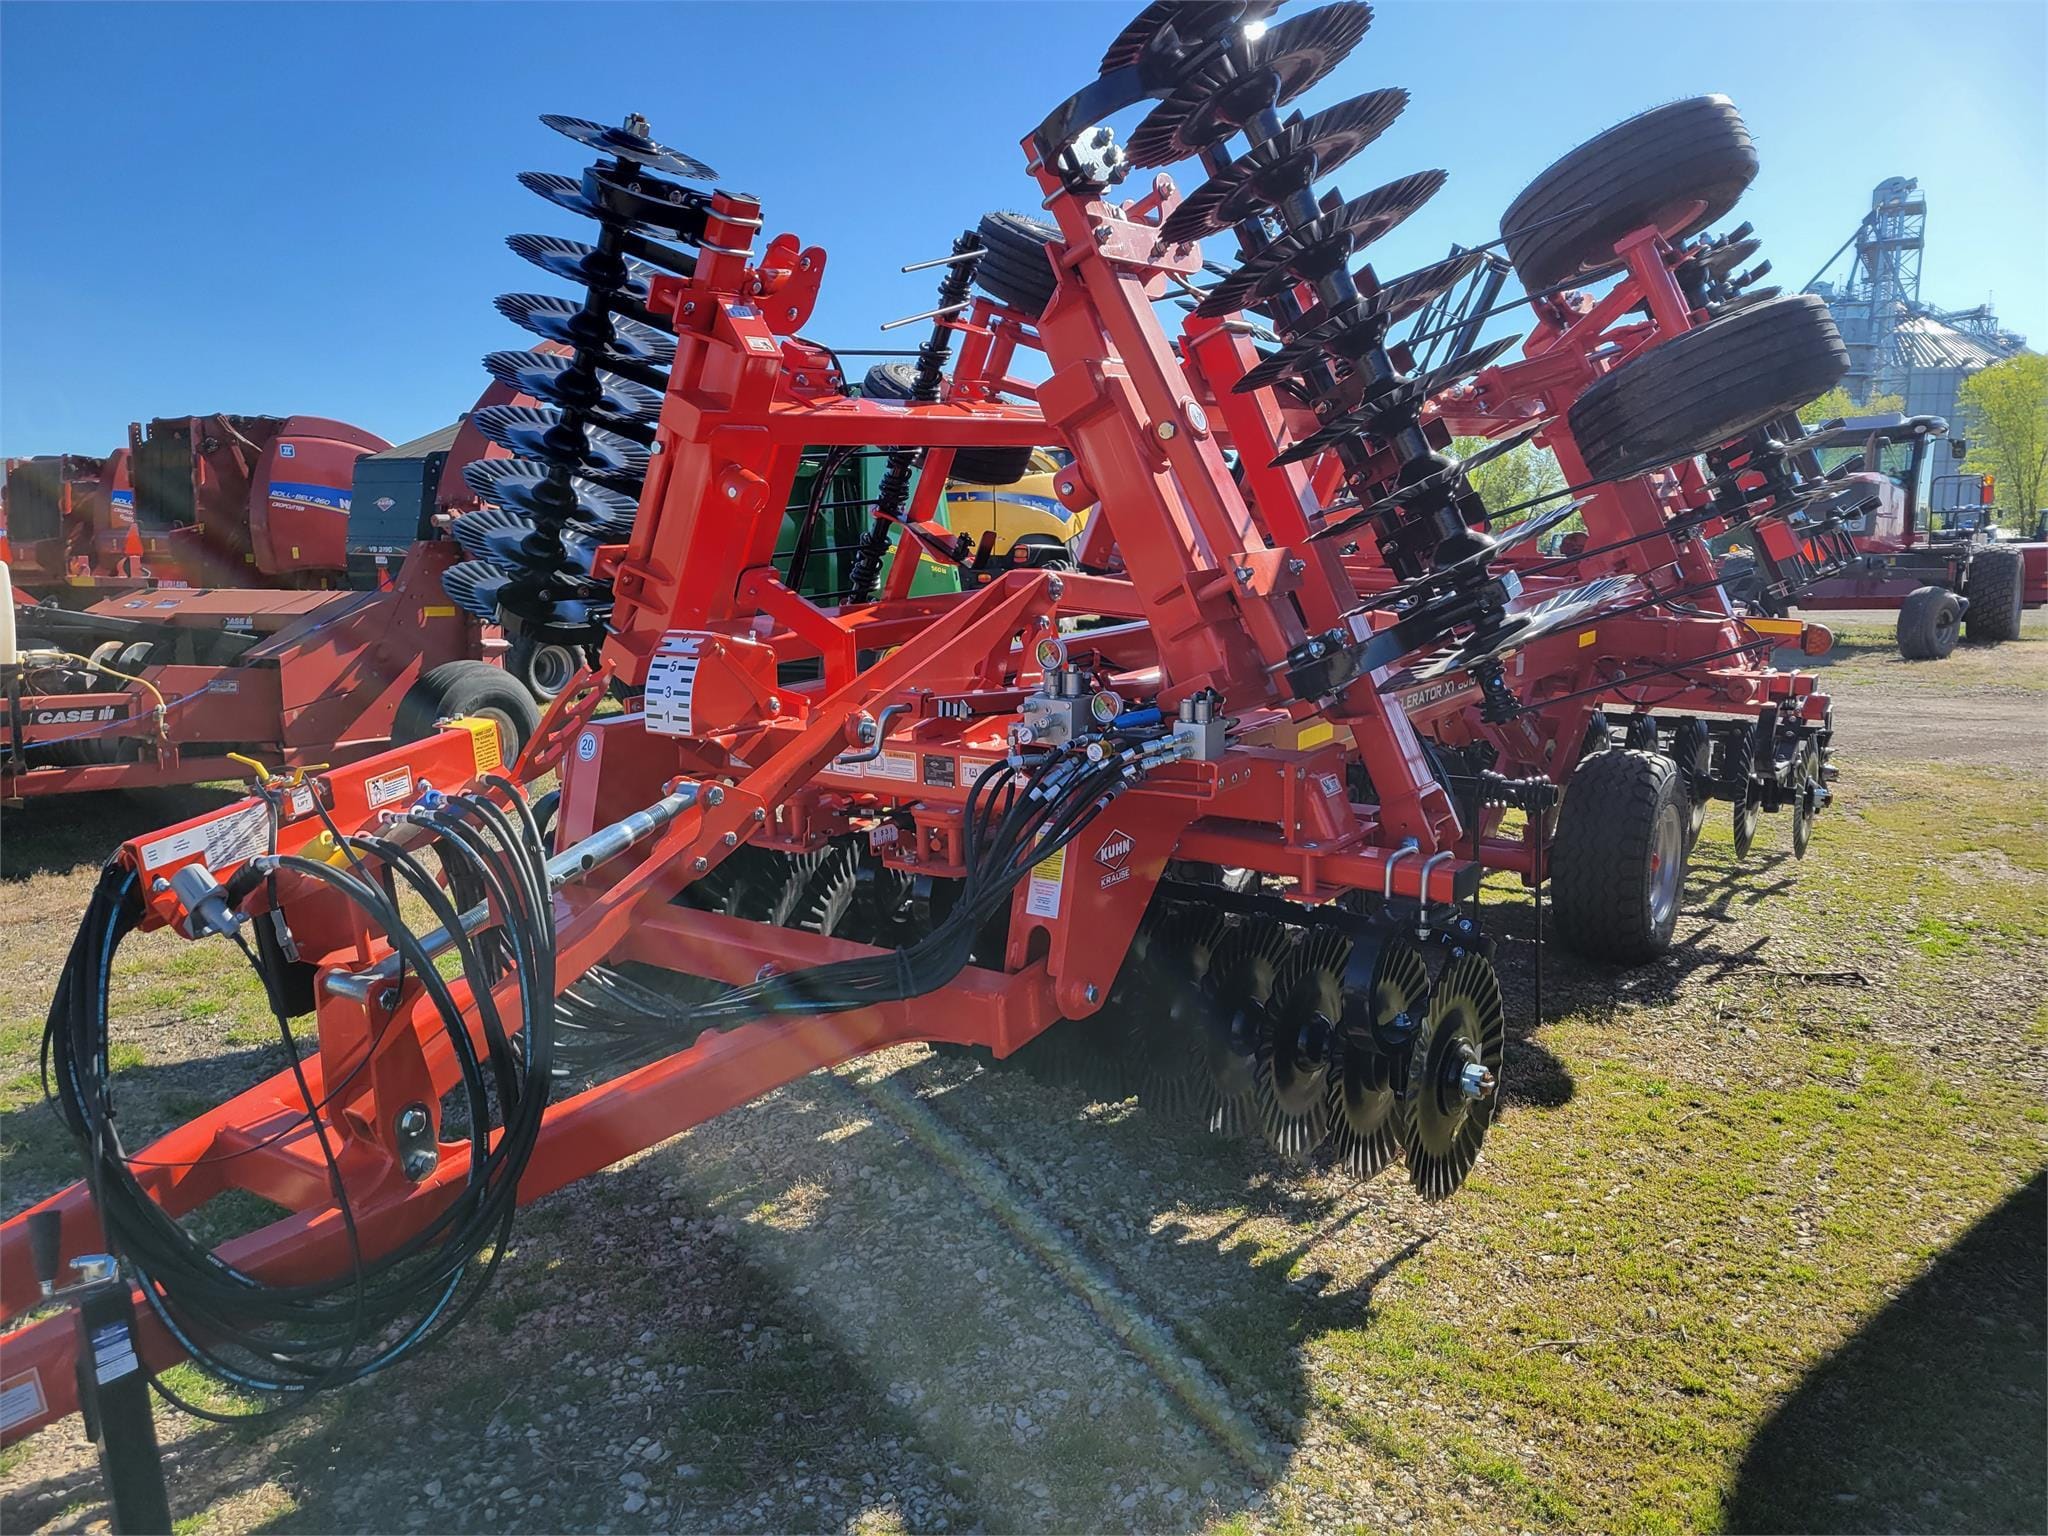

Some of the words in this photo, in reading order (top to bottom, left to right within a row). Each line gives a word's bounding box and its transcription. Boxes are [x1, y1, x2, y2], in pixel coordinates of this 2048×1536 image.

[670, 660, 678, 672] 5
[665, 686, 672, 698] 3
[1400, 684, 1442, 710] LERATOR
[38, 709, 94, 724] CASE
[665, 710, 670, 724] 1
[582, 738, 594, 751] 20
[1100, 839, 1130, 862] KUHN
[1100, 870, 1130, 887] KRAUSE
